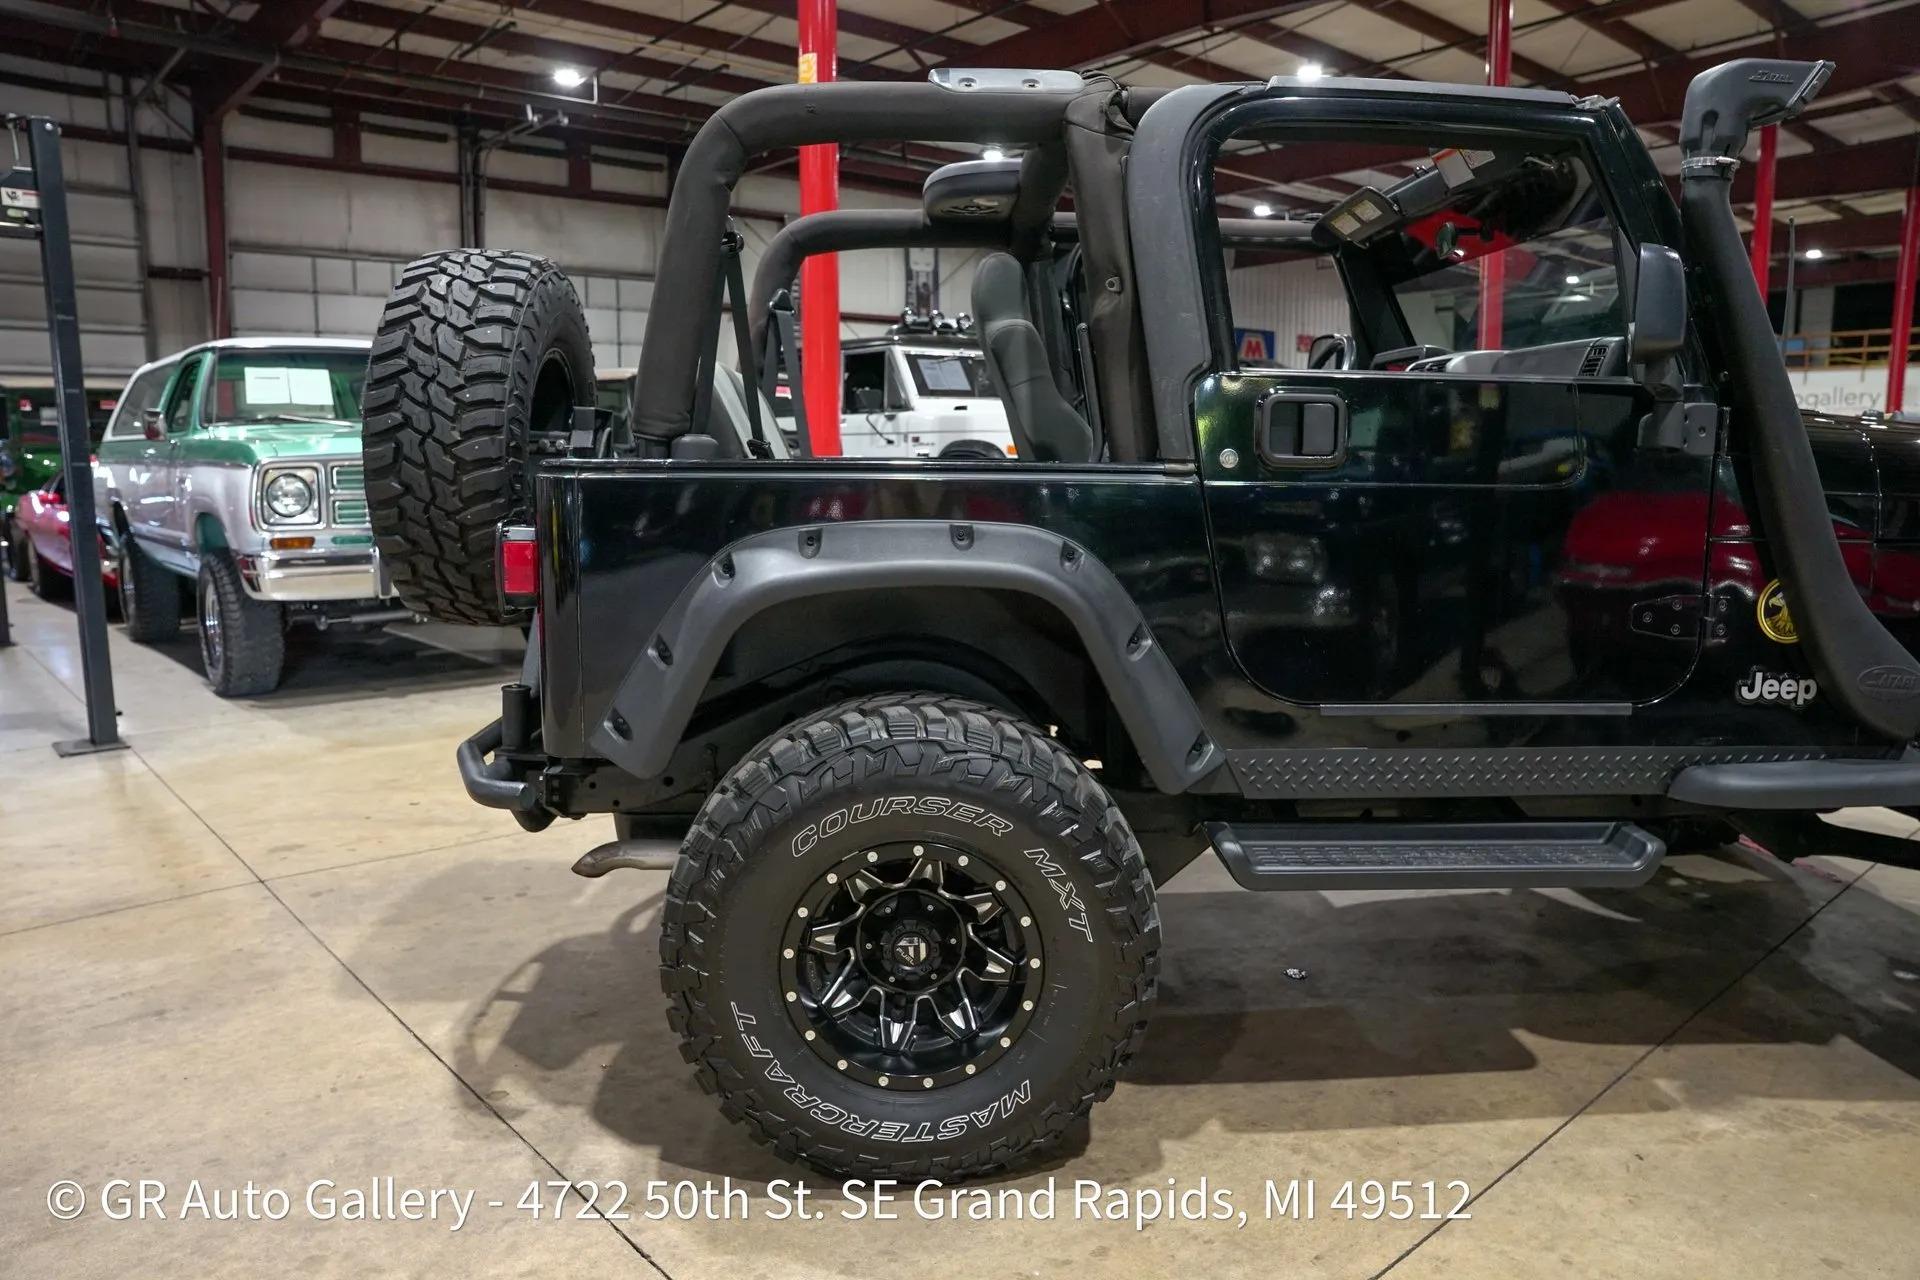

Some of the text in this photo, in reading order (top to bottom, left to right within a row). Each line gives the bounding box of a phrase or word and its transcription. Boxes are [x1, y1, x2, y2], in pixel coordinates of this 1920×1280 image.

[1740, 671, 1818, 705] Jeep
[791, 795, 1094, 943] COURSER MXT
[730, 1000, 1032, 1143] MASTERCRAFT
